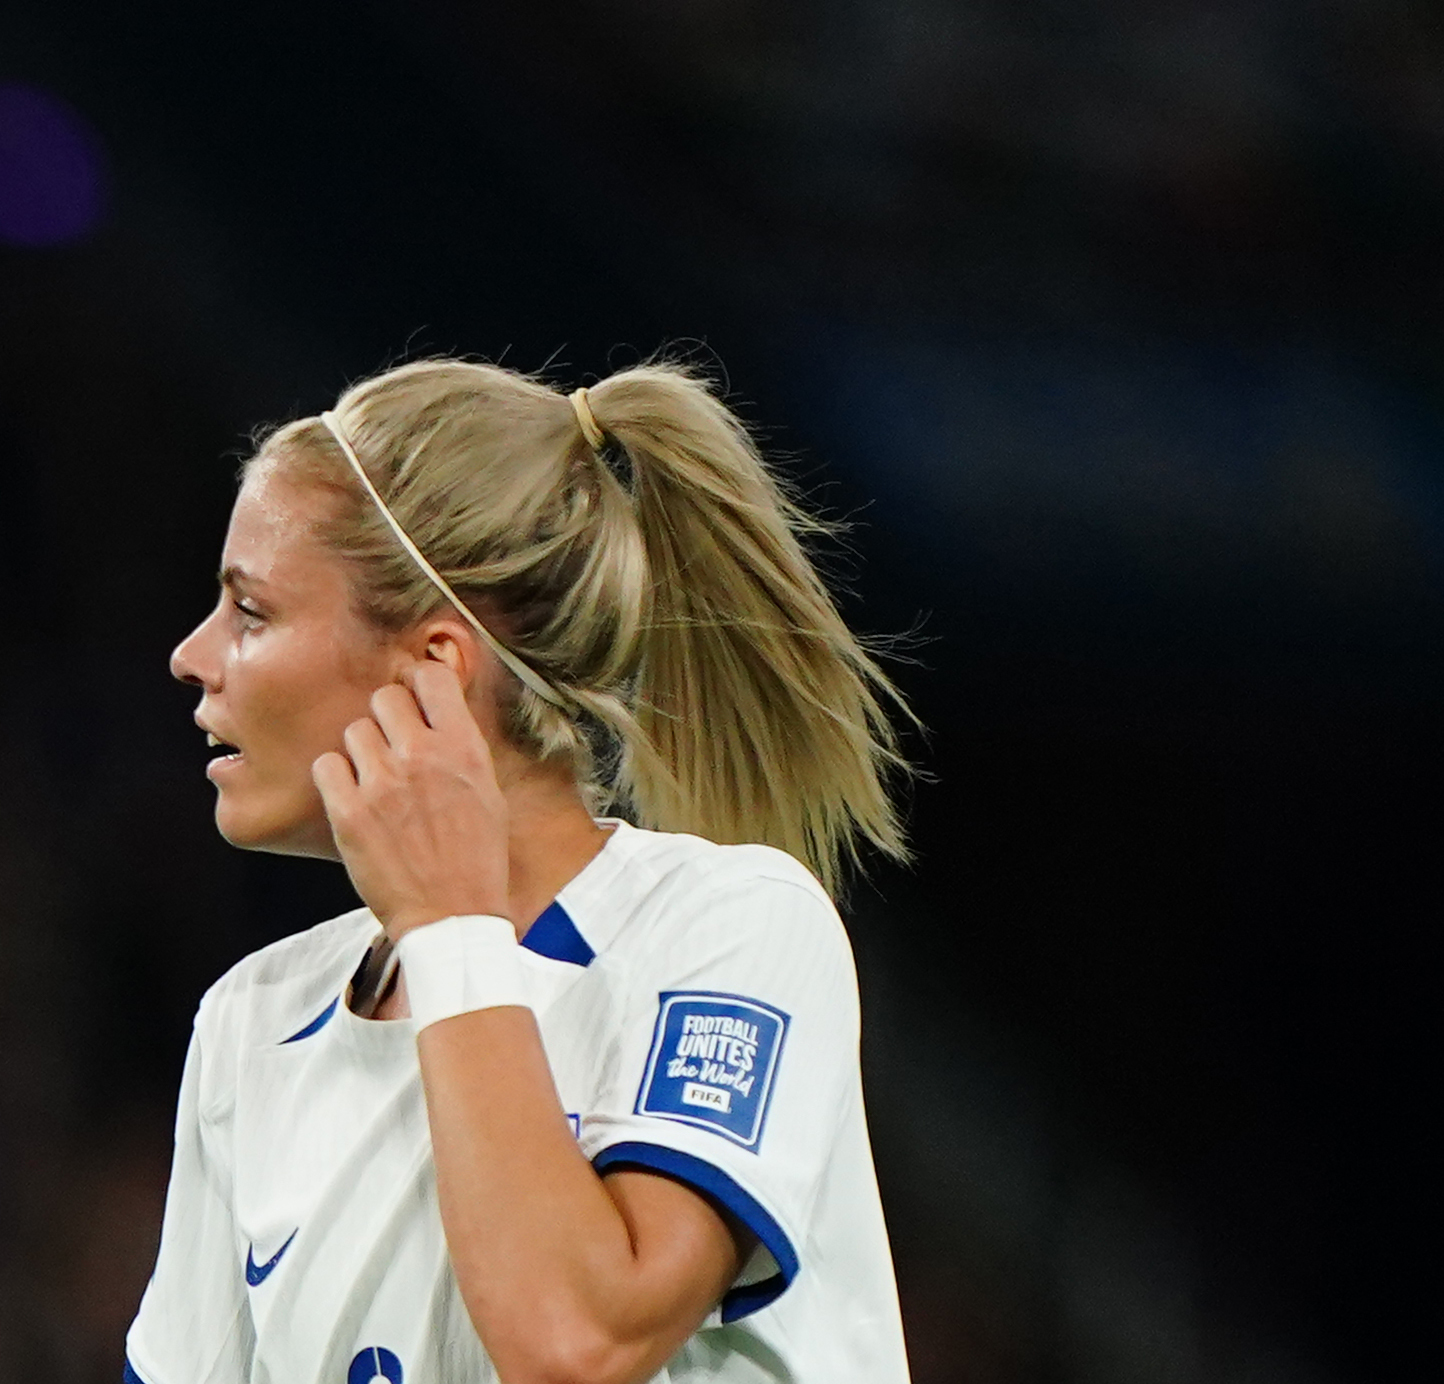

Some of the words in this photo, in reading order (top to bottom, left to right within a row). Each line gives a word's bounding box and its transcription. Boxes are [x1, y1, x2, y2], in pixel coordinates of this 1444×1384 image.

[684, 1015, 759, 1046] FOOTBALL
[676, 1034, 757, 1072] UNITES
[667, 1057, 699, 1079] the
[699, 1059, 756, 1098] World
[691, 1088, 722, 1105] FIFA
